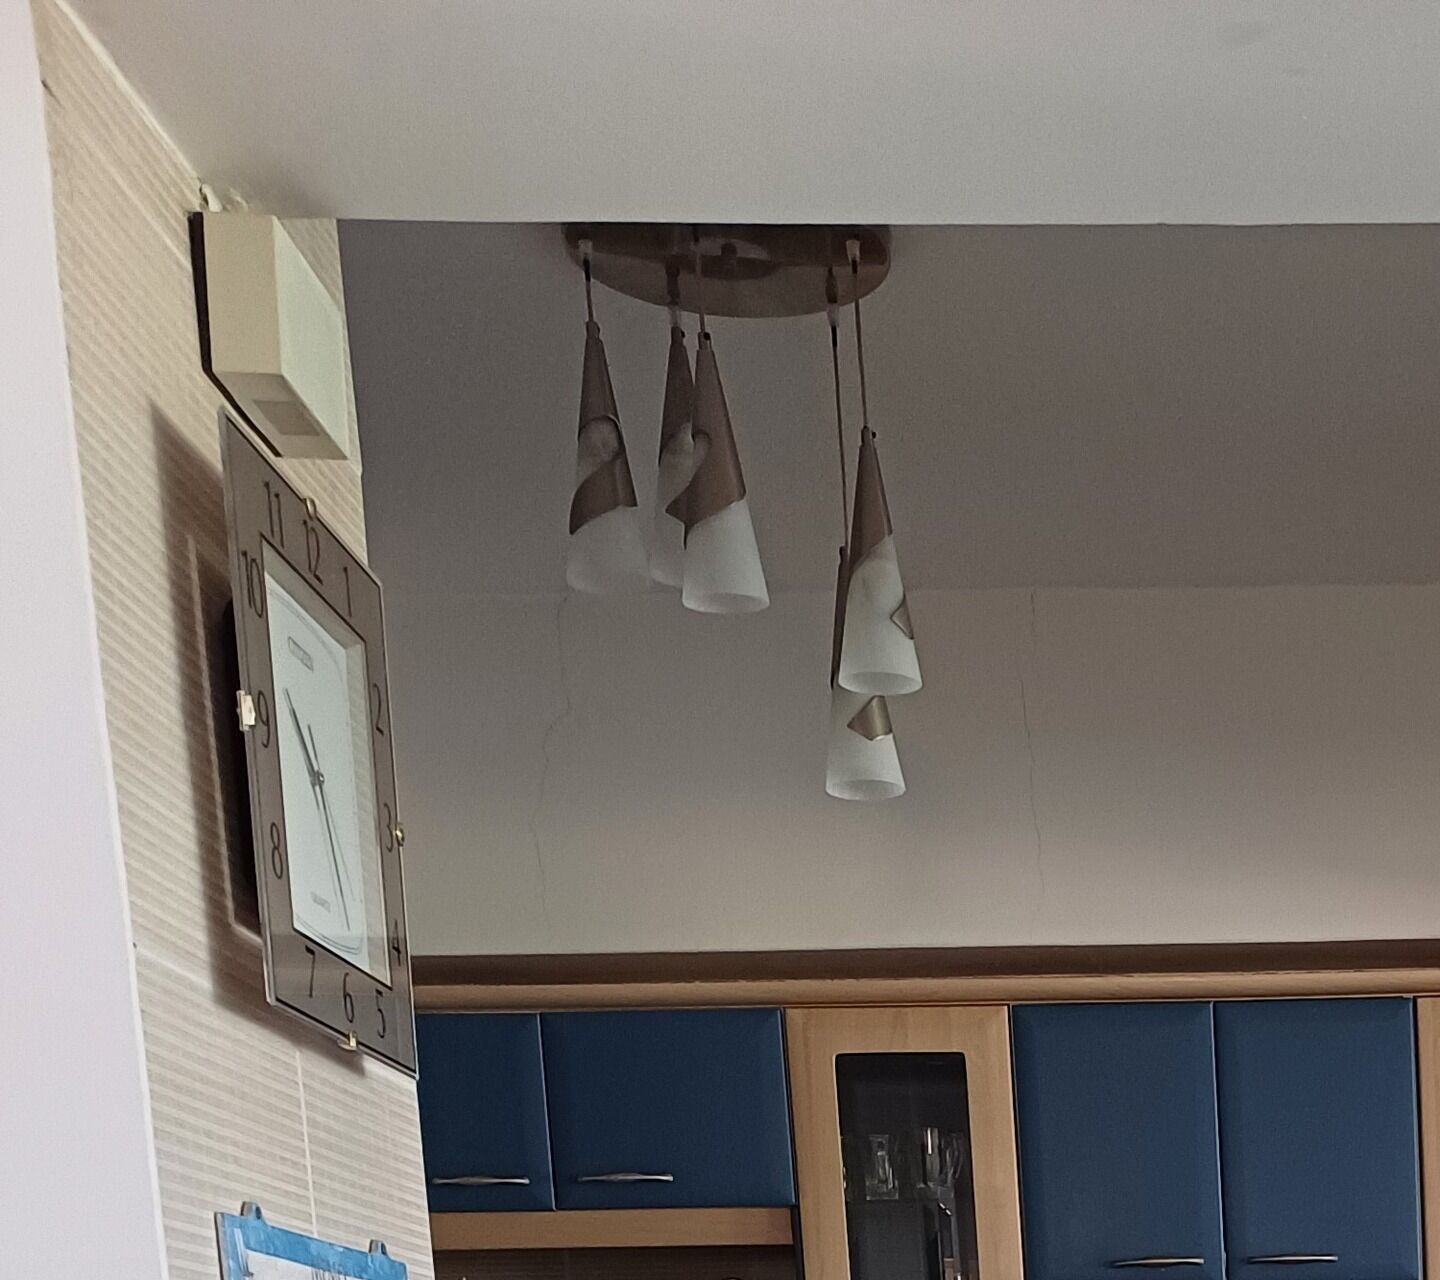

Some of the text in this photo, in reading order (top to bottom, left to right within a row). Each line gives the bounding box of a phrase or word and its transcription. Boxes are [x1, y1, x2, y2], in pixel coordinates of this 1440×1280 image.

[263, 481, 285, 549] 11
[302, 519, 324, 586] 12
[241, 550, 264, 619] 10
[343, 566, 353, 618] 1
[257, 690, 271, 748] 9
[372, 682, 385, 736] 2
[270, 821, 284, 880] 8
[383, 803, 395, 853] 3
[391, 919, 403, 967] 4
[304, 944, 316, 999] 7
[342, 972, 355, 1023] 6
[375, 988, 387, 1039] 5
